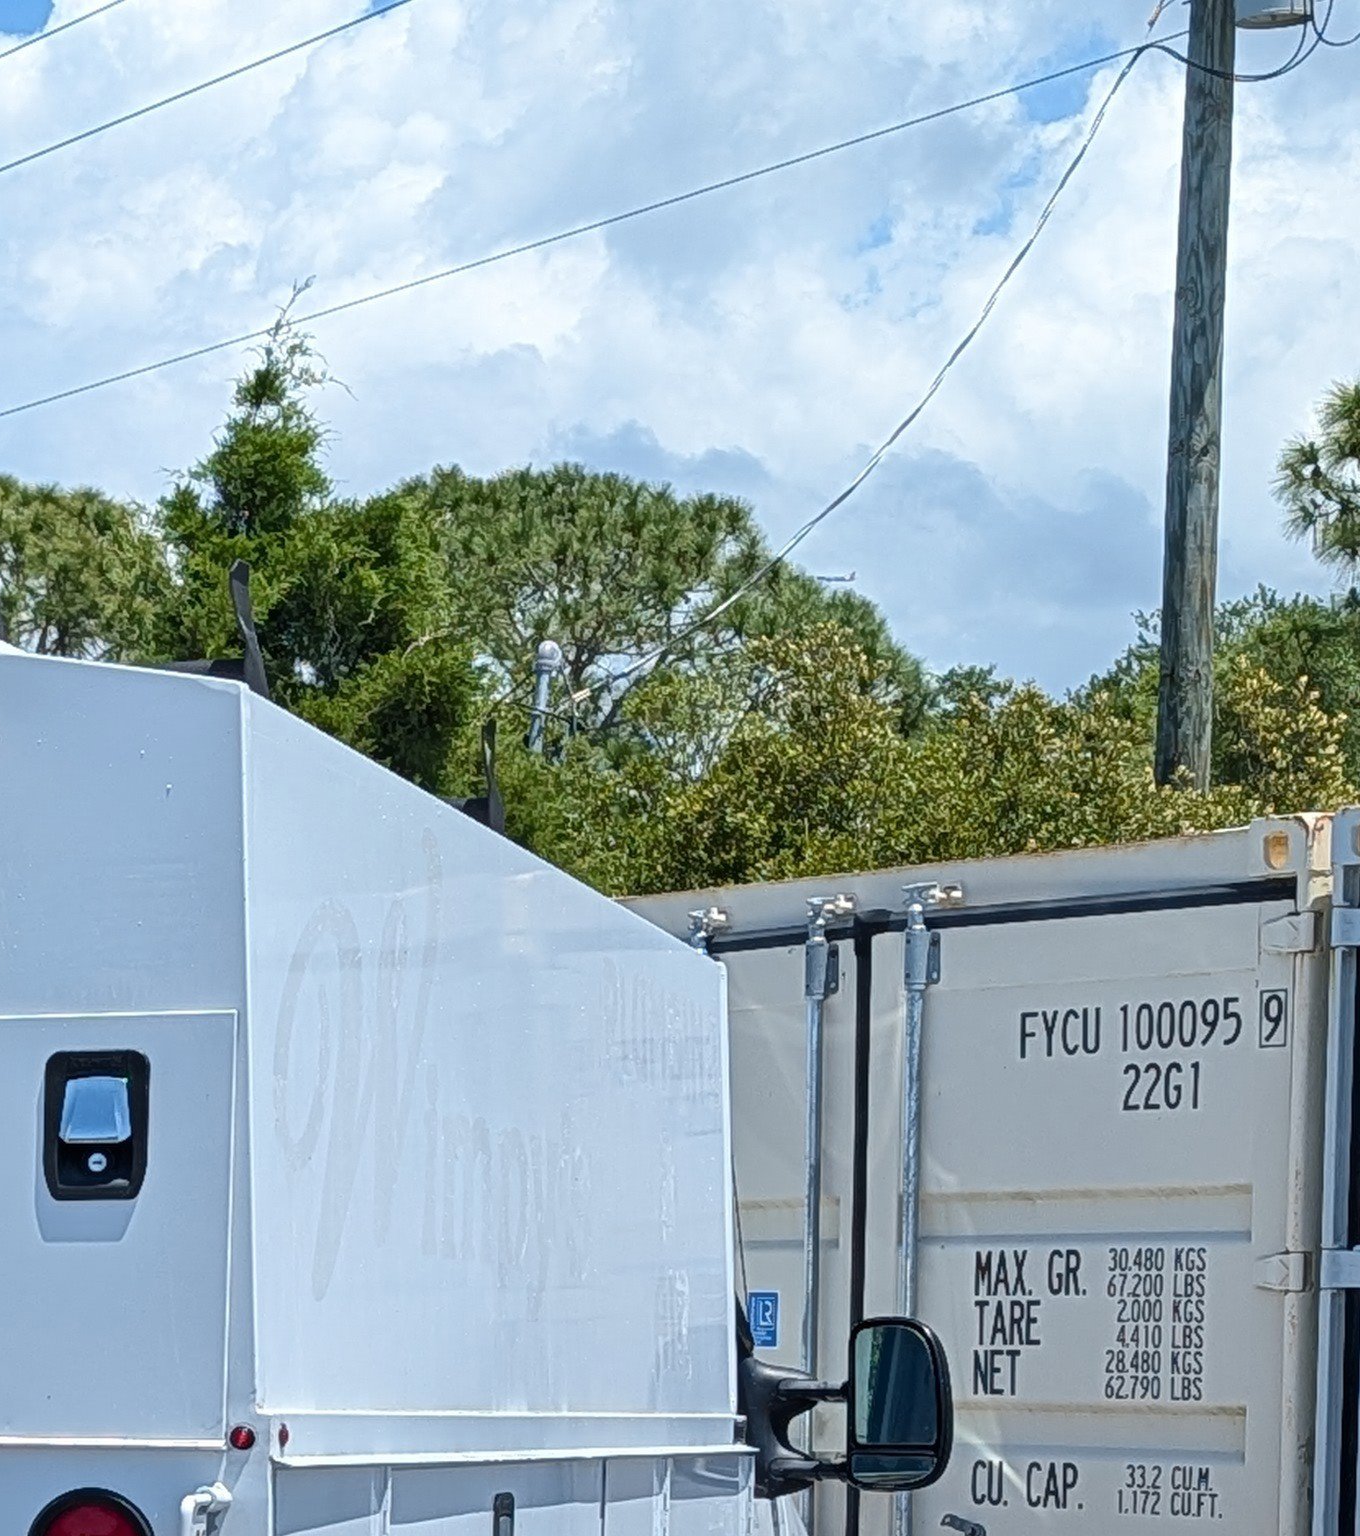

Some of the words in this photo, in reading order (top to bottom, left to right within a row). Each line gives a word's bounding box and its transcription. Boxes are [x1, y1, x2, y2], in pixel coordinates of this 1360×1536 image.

[1020, 1006, 1101, 1059] FYCU
[1119, 997, 1242, 1052] 100095
[1262, 992, 1285, 1045] 9
[1122, 1060, 1200, 1111] 22G1
[974, 1249, 1033, 1296] MAX.
[1048, 1249, 1087, 1296] GR.
[1108, 1247, 1165, 1272] 30.480
[1174, 1247, 1207, 1272] KGS
[1107, 1273, 1164, 1298] 67.200
[1173, 1273, 1206, 1298] LBS
[974, 1300, 1041, 1346] TARE
[1172, 1299, 1205, 1323] KGS
[1116, 1325, 1162, 1348] 4.410
[1171, 1325, 1204, 1349] LBS
[973, 1350, 1021, 1396] NET
[1105, 1350, 1161, 1374] 28.480
[1170, 1351, 1203, 1375] KGS
[1105, 1375, 1160, 1400] 62.790
[1170, 1376, 1202, 1401] LBS
[971, 1459, 1008, 1507] CU.
[1026, 1461, 1084, 1510] CAP.
[1125, 1464, 1162, 1490] 33.2
[1170, 1492, 1223, 1519] CU.FT.
